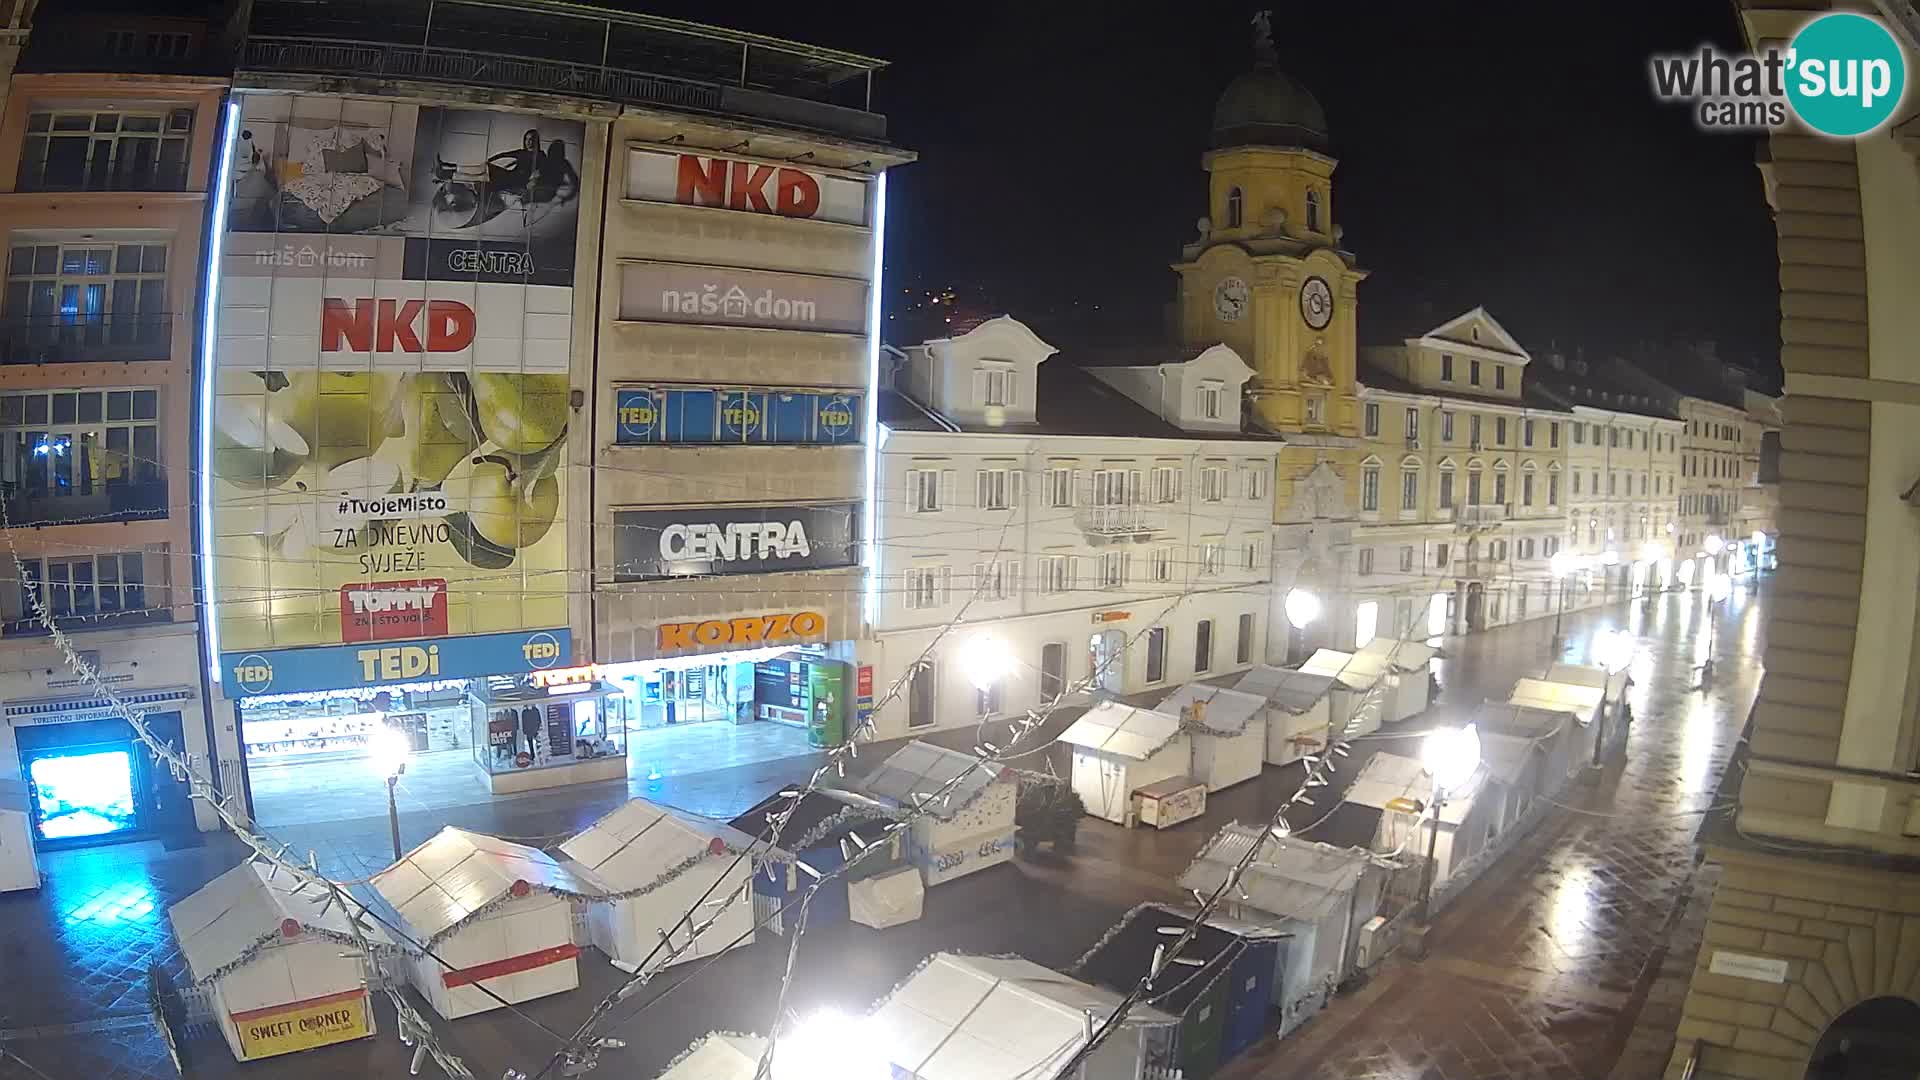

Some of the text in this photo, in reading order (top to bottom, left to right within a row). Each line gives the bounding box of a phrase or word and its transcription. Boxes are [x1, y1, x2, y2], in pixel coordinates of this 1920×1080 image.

[676, 154, 820, 218] NKD
[448, 249, 535, 275] CENTRA
[661, 283, 816, 321] naš dom
[321, 297, 477, 353] NKD
[338, 497, 446, 516] #TvojeMisto
[334, 523, 450, 548] ZA DNEVNO
[659, 520, 811, 561] CENTRA
[360, 546, 426, 574] SVJEŽE
[348, 585, 439, 613] TOMMY
[659, 611, 825, 650] KORZO
[358, 644, 440, 681] TEDi
[522, 642, 560, 659] TEDi
[234, 665, 273, 683] TEDi
[250, 1020, 293, 1041] SWEET
